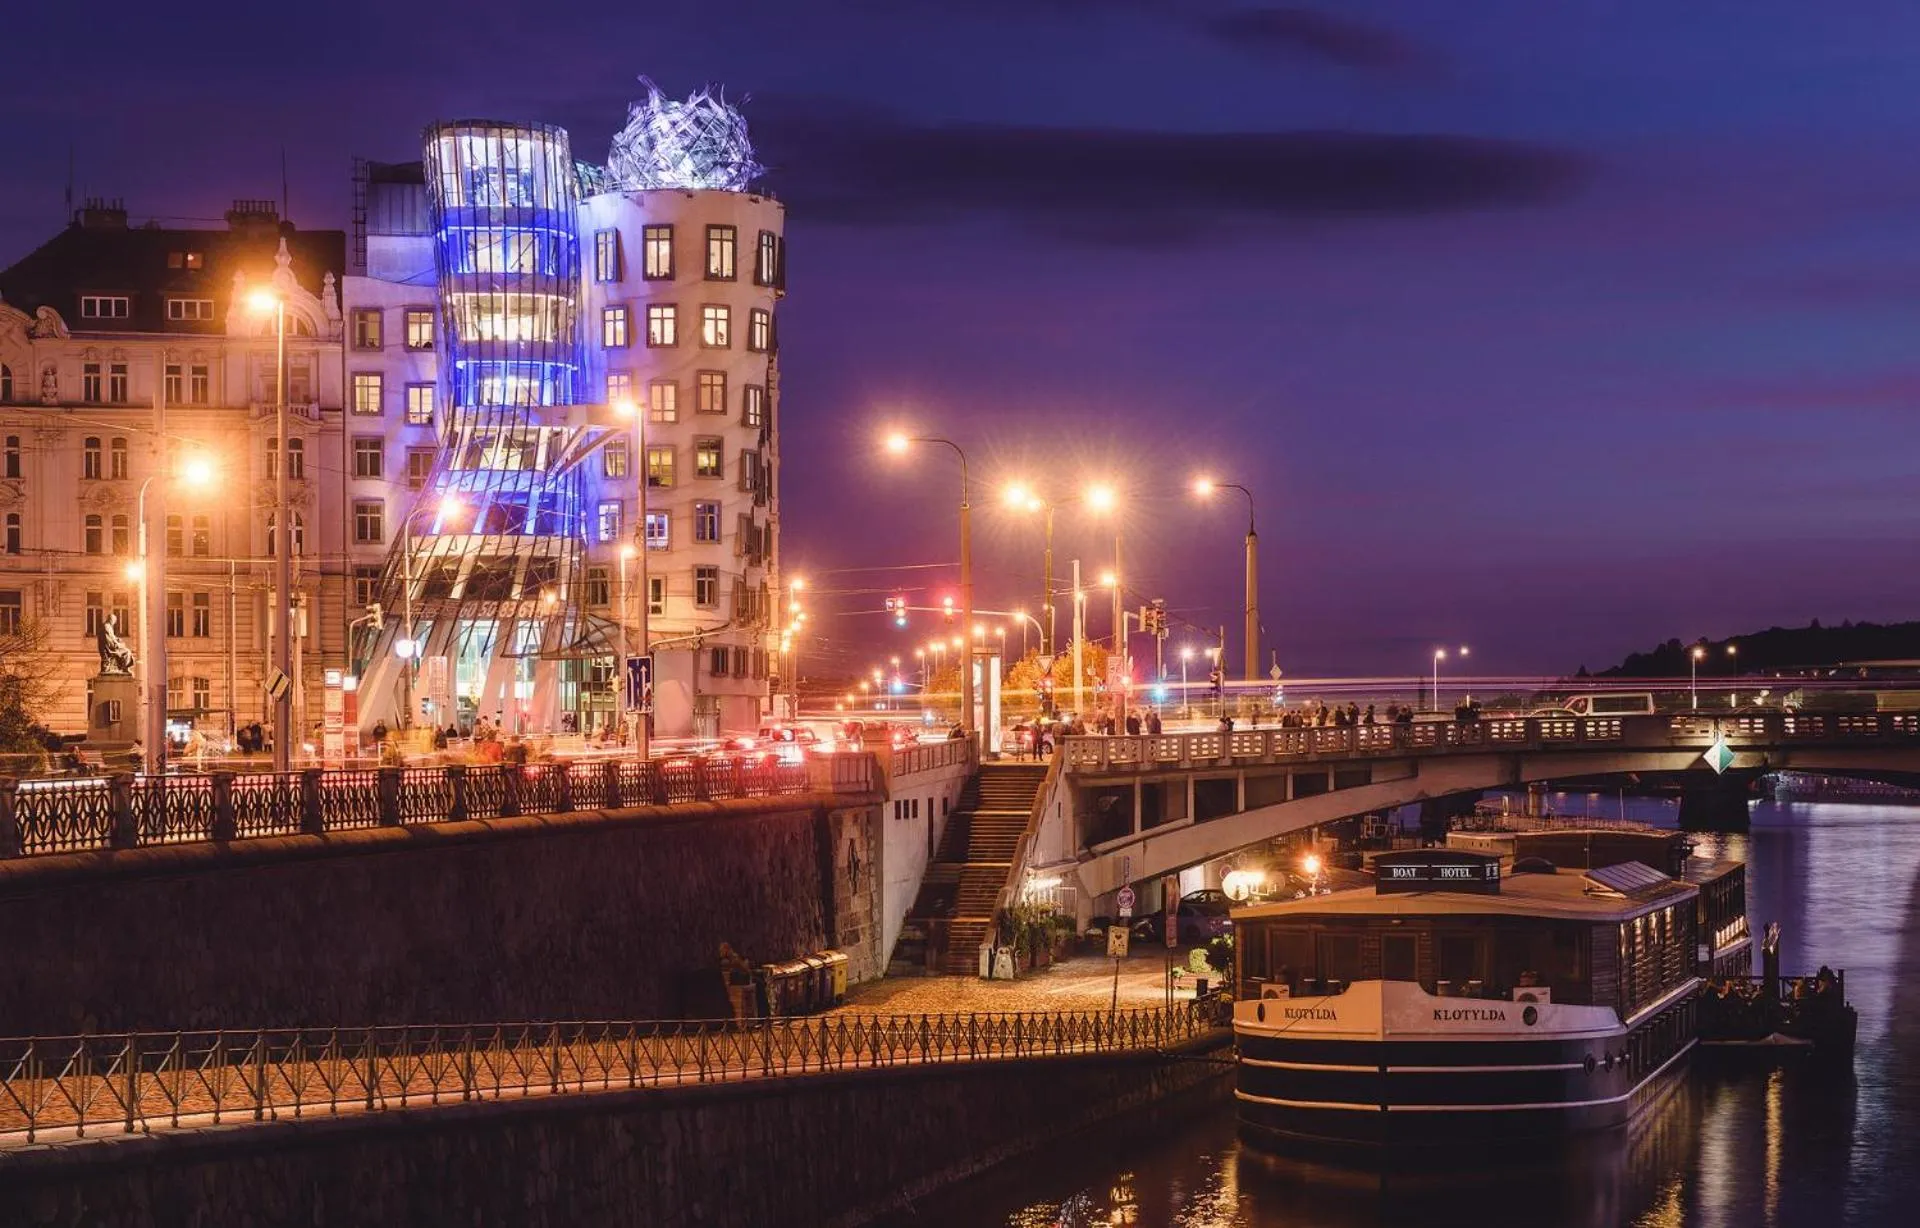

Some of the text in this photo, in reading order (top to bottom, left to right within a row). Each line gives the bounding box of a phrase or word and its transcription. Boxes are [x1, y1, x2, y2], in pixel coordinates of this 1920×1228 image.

[1392, 867, 1417, 878] BOAT
[1441, 867, 1472, 878] HOTEL
[1284, 1008, 1337, 1020] KLOTYLDA
[1433, 1009, 1506, 1021] KLOTYLDA
